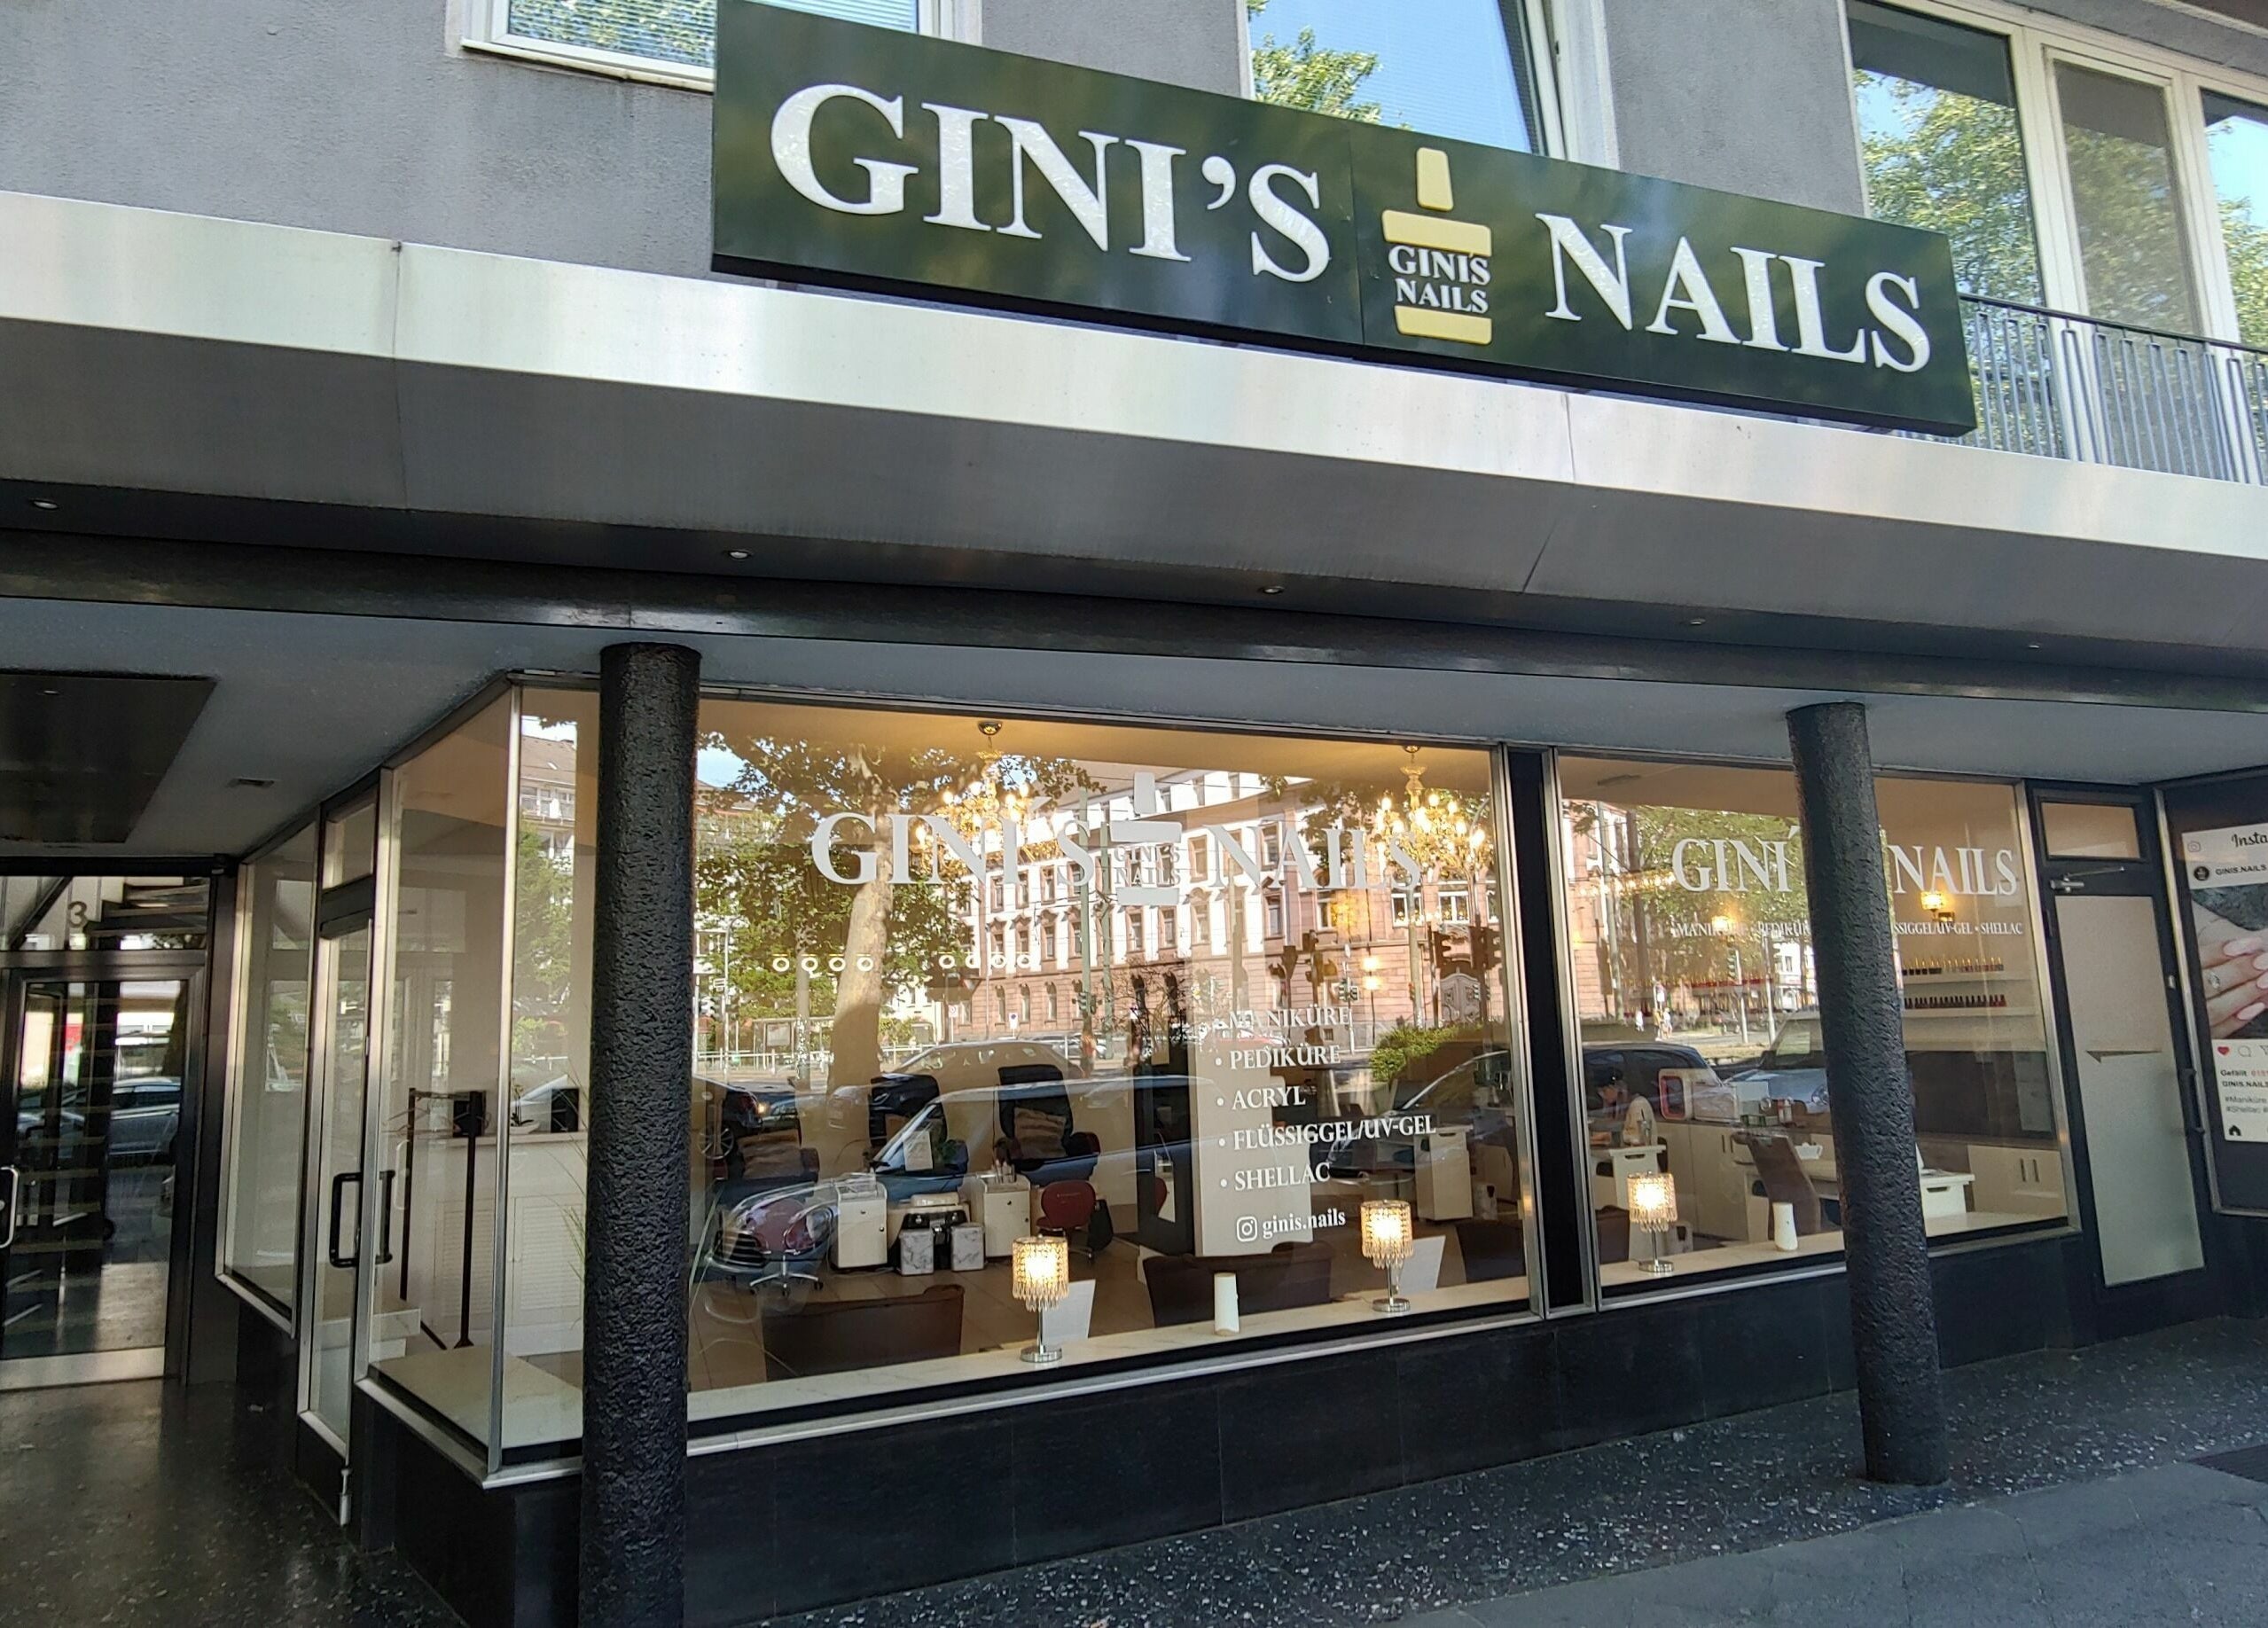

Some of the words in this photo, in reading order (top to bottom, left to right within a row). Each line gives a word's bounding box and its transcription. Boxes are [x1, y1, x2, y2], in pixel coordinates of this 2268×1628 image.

[770, 83, 1332, 284] GINI'S
[1535, 213, 1930, 372] NAILS
[1395, 278, 1489, 314] NAILS
[2231, 832, 2268, 848] Insta
[1203, 824, 1421, 891] NAILS
[1889, 845, 2018, 896] NAILS
[1114, 866, 1181, 886] NAILS
[67, 901, 87, 928] 3
[1980, 922, 2023, 935] SHELLAC
[1229, 1003, 1351, 1030] MANIKÜRE
[1230, 1042, 1341, 1070] PEDIKÜRE
[1232, 1085, 1307, 1111] ACRYL
[1233, 1115, 1437, 1151] FLÜSSIGGEL/UV-GEL
[1234, 1162, 1331, 1192] SHELLAC
[1262, 1208, 1346, 1239] ginis.nails
